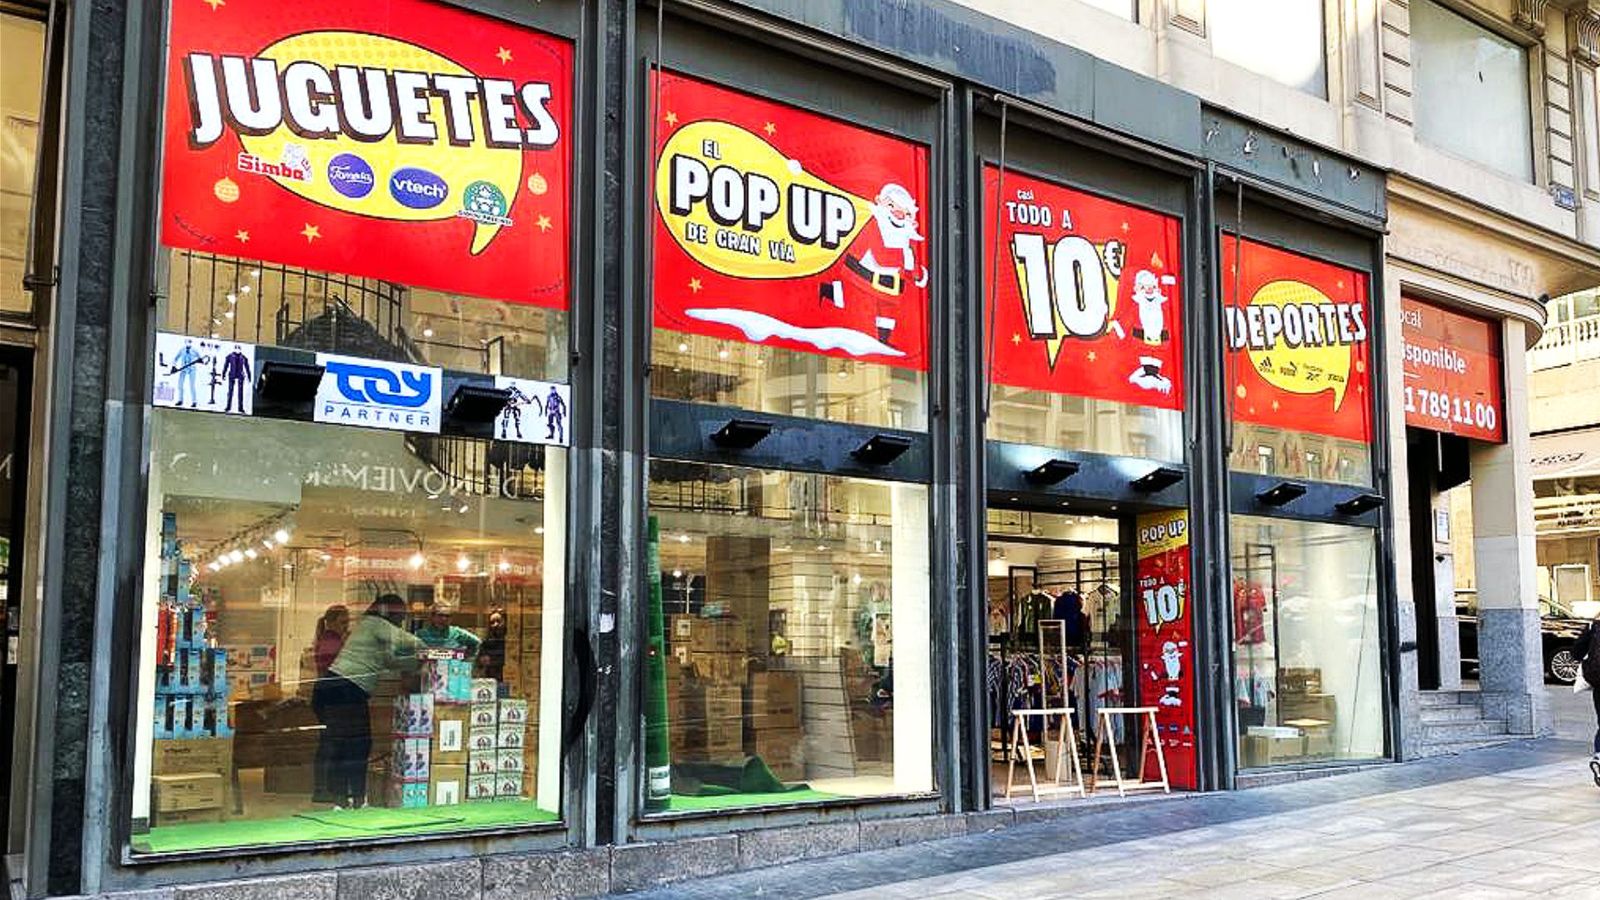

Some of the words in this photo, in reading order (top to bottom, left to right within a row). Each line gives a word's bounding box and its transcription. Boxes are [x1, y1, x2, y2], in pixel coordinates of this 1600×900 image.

[184, 52, 560, 151] JUGUETES
[702, 139, 722, 160] EL
[239, 154, 305, 181] Simba
[669, 154, 780, 232] POP
[787, 183, 856, 249] UP
[1006, 201, 1052, 227] TODO
[1061, 209, 1074, 231] A
[685, 222, 708, 244] DE
[715, 228, 761, 256] GRAN
[769, 237, 796, 262] VÍA
[1225, 302, 1367, 350] DEPORTES
[1399, 308, 1422, 328] ocal
[1401, 336, 1466, 374] isponible
[324, 405, 430, 426] PARTNER
[1141, 524, 1166, 544] POP
[1168, 519, 1186, 539] UP
